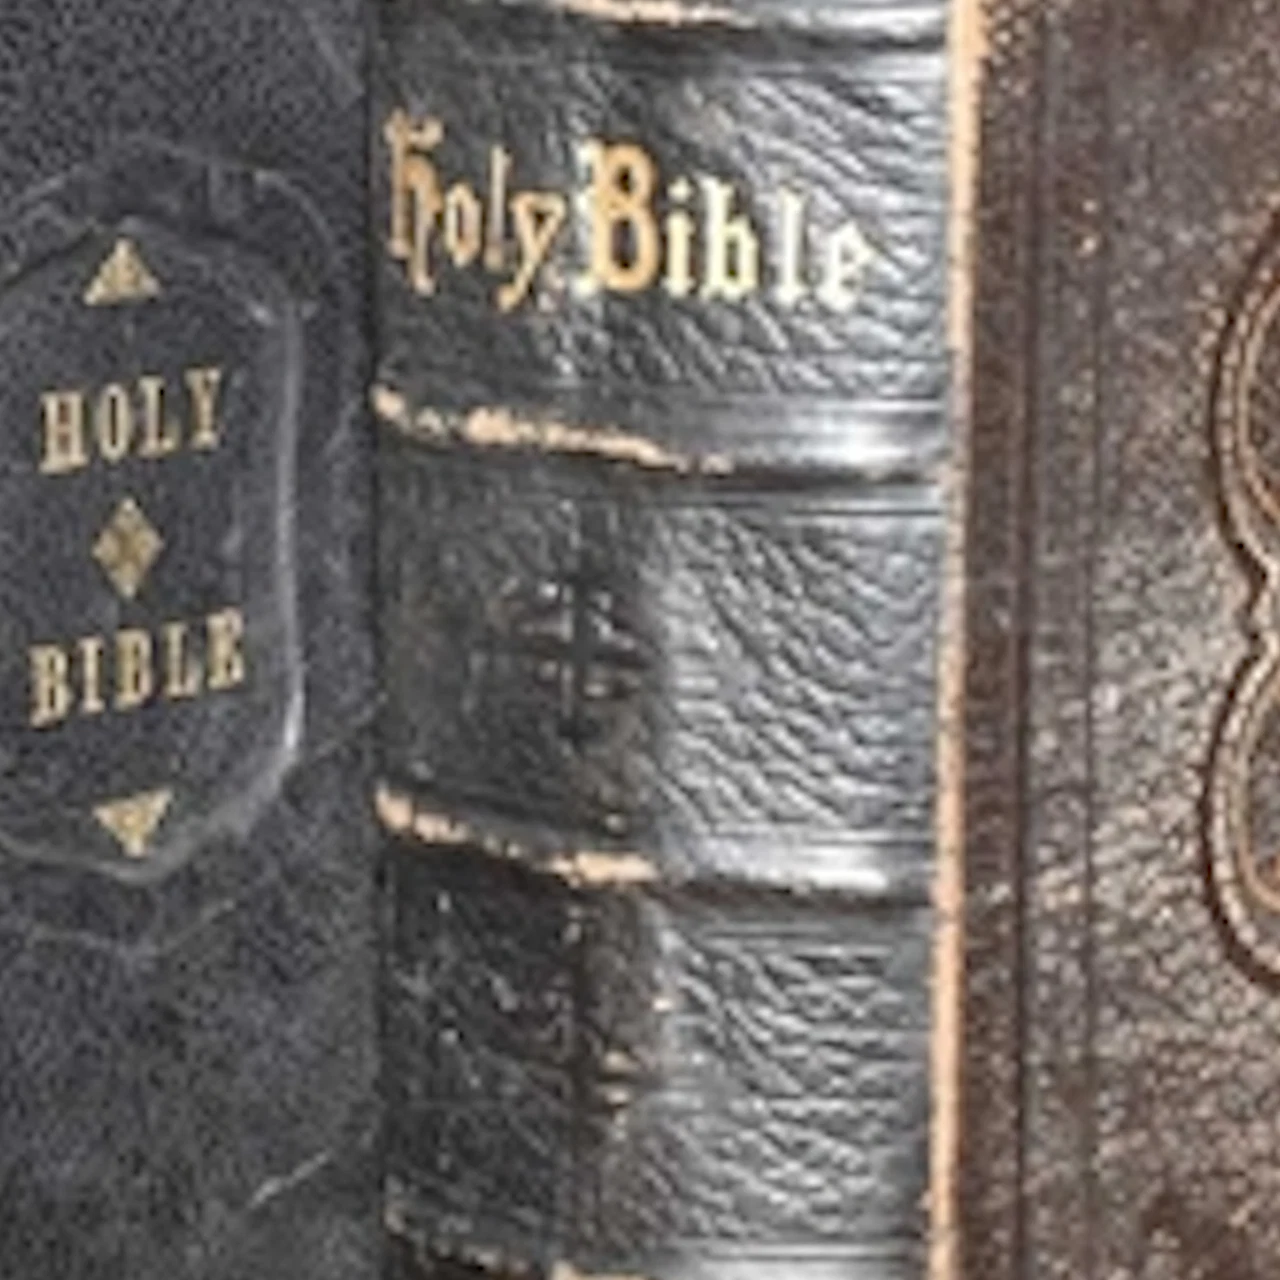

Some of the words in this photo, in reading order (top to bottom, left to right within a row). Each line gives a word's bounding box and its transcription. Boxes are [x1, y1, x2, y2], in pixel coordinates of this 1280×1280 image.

[384, 108, 567, 311] Holy
[575, 136, 872, 311] Bible
[38, 366, 222, 474] HOLY
[28, 606, 245, 728] BIBLE
